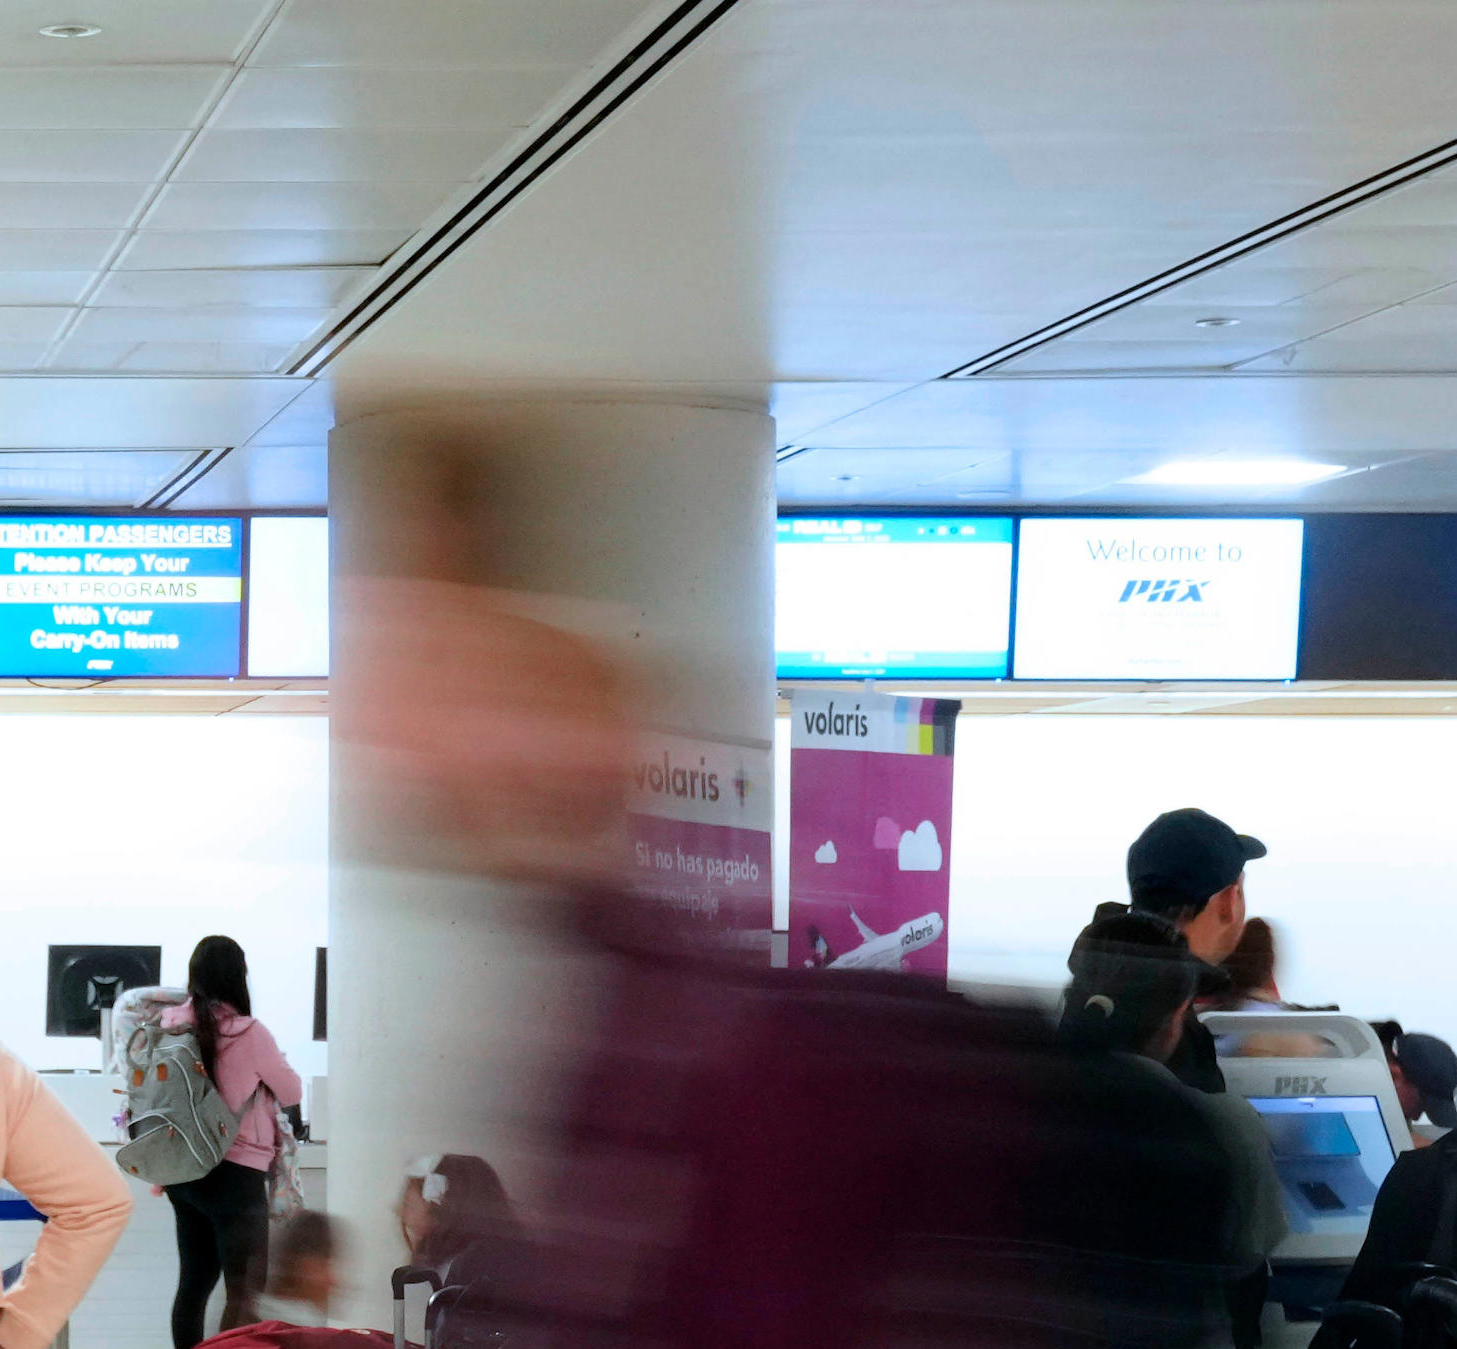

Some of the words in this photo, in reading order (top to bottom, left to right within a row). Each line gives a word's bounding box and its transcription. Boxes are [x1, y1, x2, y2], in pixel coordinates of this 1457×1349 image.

[89, 525, 232, 545] PASSENGERS
[1085, 538, 1207, 563] Welcome
[1217, 541, 1243, 563] to
[14, 554, 80, 573] Please
[85, 554, 137, 575] Keep
[140, 554, 189, 573] Your
[6, 582, 70, 598] EVENT
[79, 581, 198, 598] PROGRAMS
[1118, 578, 1213, 604] PHX
[53, 606, 99, 625] With
[103, 606, 152, 626] Your
[30, 630, 119, 653] Carry-On
[124, 631, 179, 650] Items
[804, 701, 868, 738] volaris
[631, 752, 720, 802] volaris
[655, 850, 673, 870] no
[677, 844, 703, 874] has
[707, 854, 760, 885] pagado
[901, 919, 934, 948] volaris
[1274, 1076, 1328, 1095] PHX
